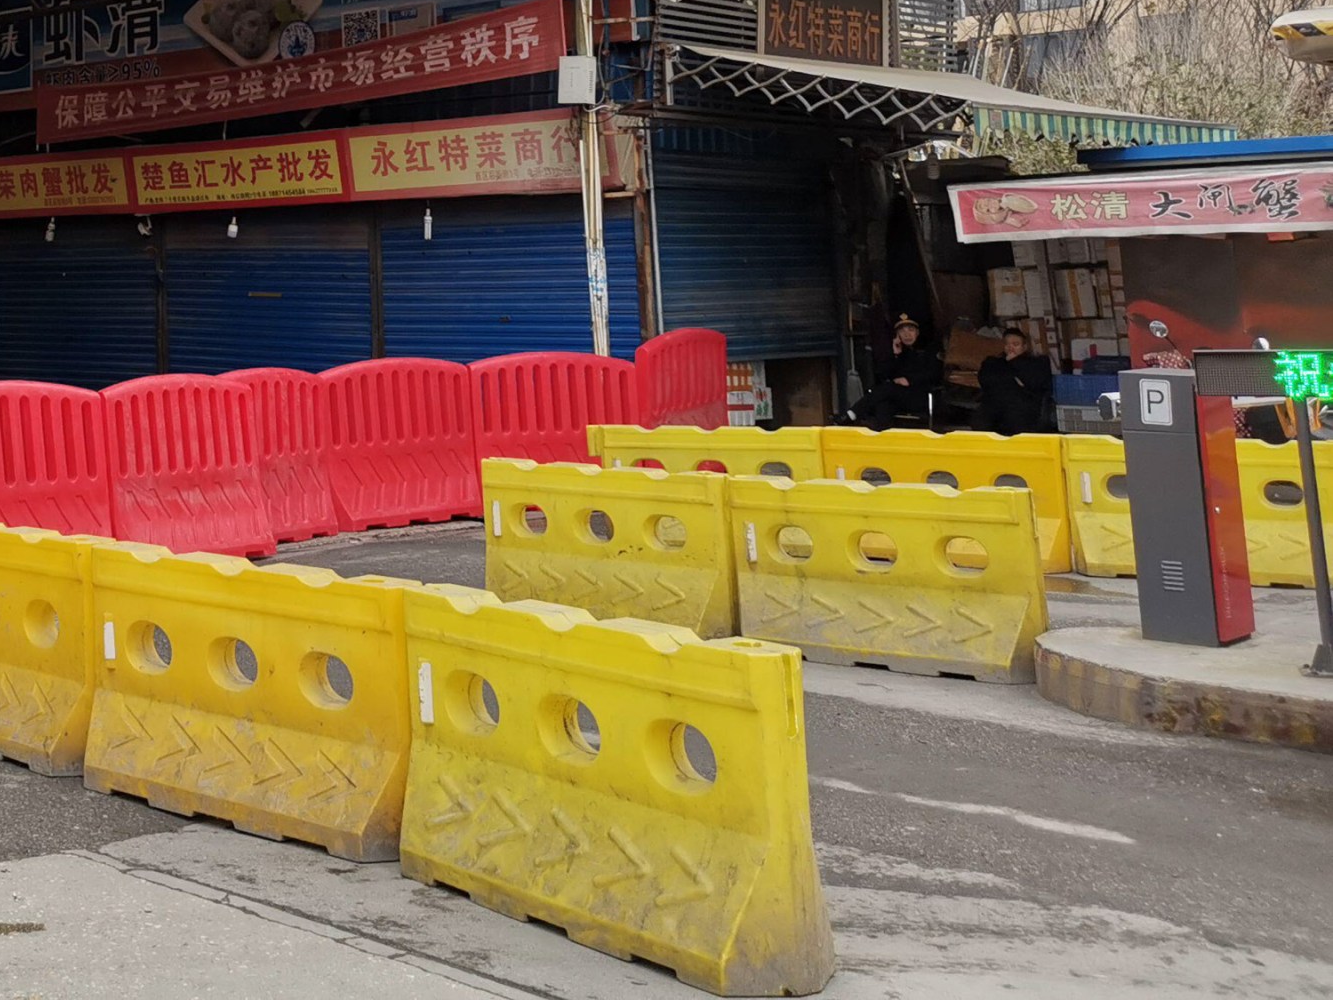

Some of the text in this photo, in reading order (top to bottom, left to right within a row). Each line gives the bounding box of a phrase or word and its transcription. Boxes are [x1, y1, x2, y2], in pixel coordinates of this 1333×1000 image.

[54, 14, 540, 130] 保障公平交易维护市场经营秩序
[141, 149, 334, 191] 楚鱼汇水产批发
[1273, 351, 1333, 397] 祝
[1147, 390, 1165, 414] P
